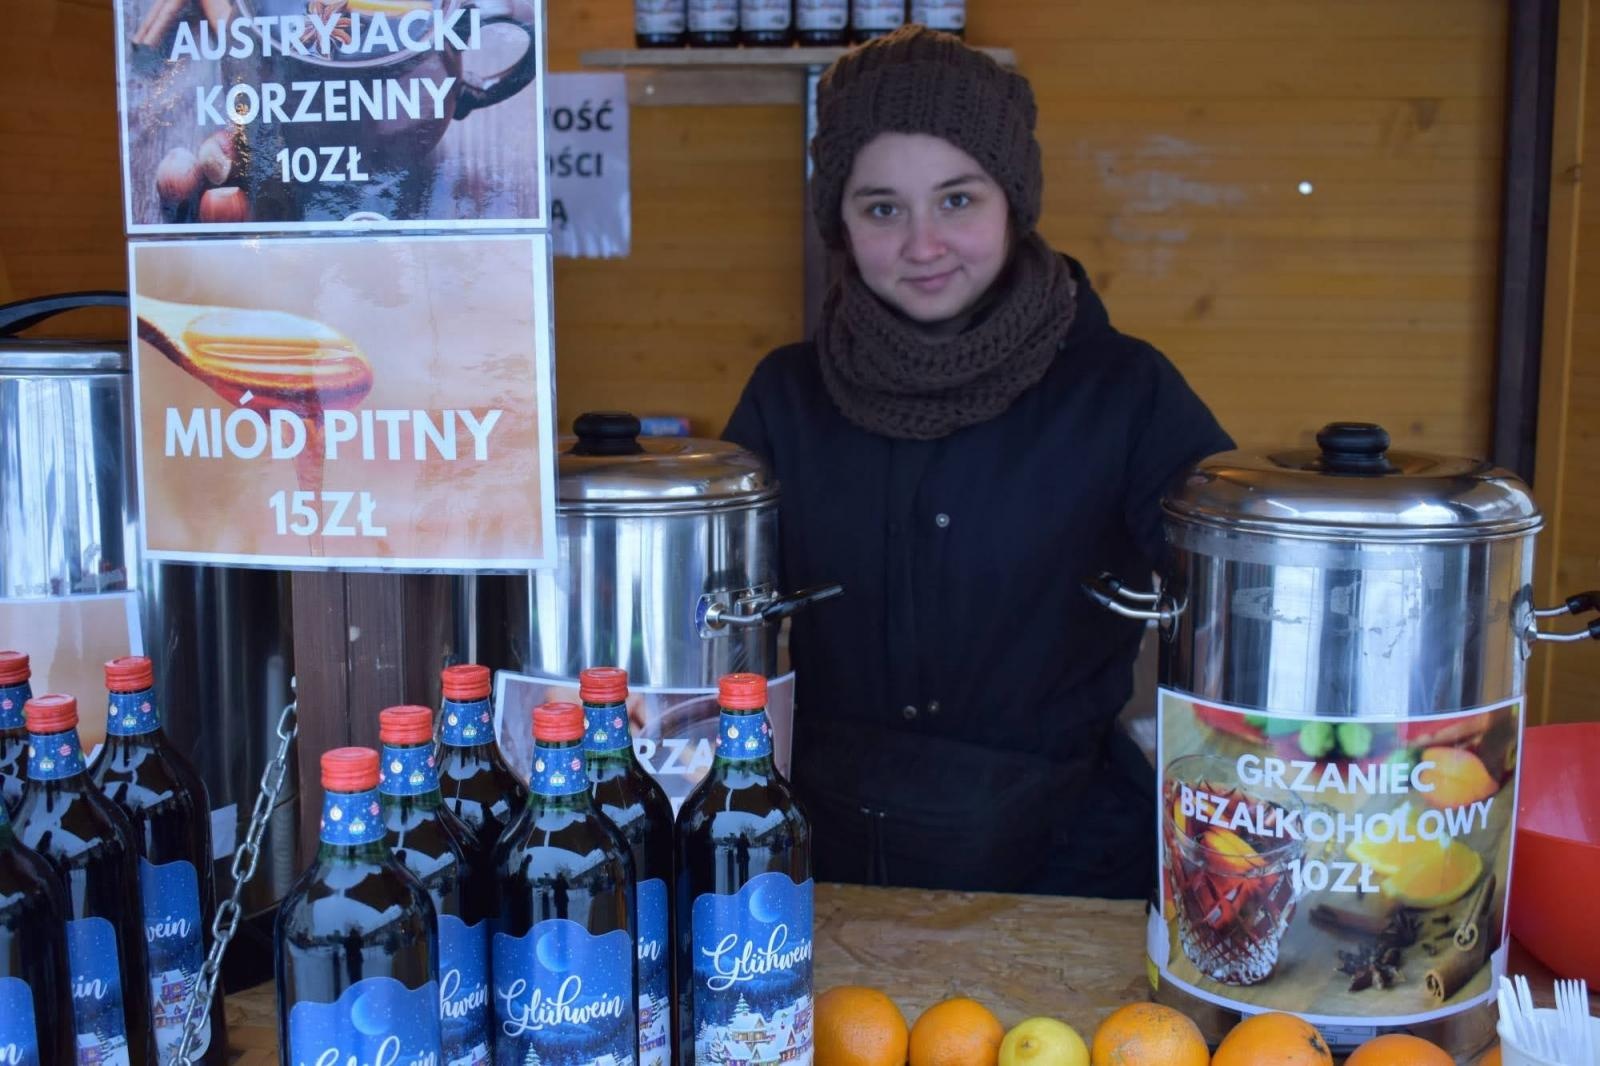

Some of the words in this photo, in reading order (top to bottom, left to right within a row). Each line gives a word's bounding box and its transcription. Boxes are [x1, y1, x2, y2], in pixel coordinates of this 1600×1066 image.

[170, 8, 481, 61] AUSTRYJACKI
[196, 77, 456, 127] KORZENNY
[552, 99, 614, 132] OŚĆ
[276, 146, 369, 184] 10ZŁ
[549, 146, 604, 178] ŚCI
[165, 389, 307, 460] MIÓD
[325, 409, 503, 461] PITNY
[269, 490, 388, 537] 15ZŁ
[632, 737, 715, 775] RZA
[1236, 753, 1436, 795] GRZANIEC
[1180, 787, 1495, 844] BEZALKOHOLOWY
[1287, 859, 1381, 894] 10ZŁ
[701, 923, 813, 991] Glühwein
[439, 968, 489, 1020] hwein
[499, 975, 625, 1037] Glühwein
